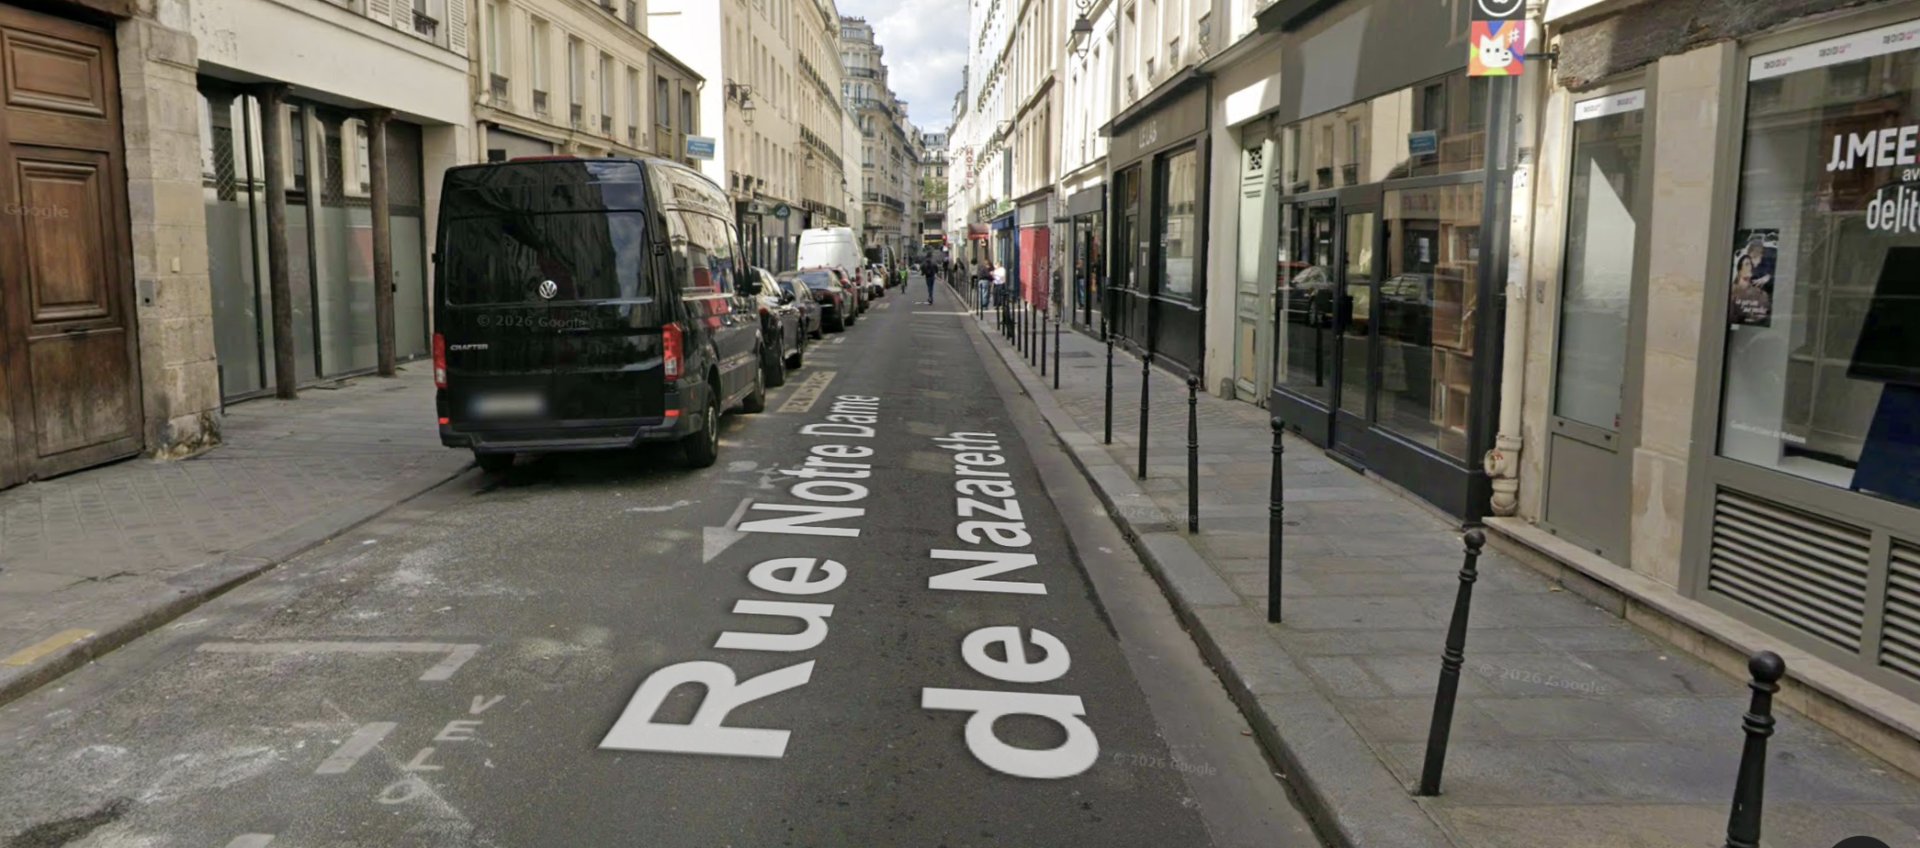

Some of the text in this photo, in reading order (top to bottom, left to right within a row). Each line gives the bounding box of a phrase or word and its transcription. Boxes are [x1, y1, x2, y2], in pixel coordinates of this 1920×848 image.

[966, 146, 974, 187] HOTEL
[1826, 125, 1920, 172] J.MEE
[1902, 168, 1920, 181] av
[1866, 185, 1920, 233] delit
[450, 343, 488, 351] CRAFTER
